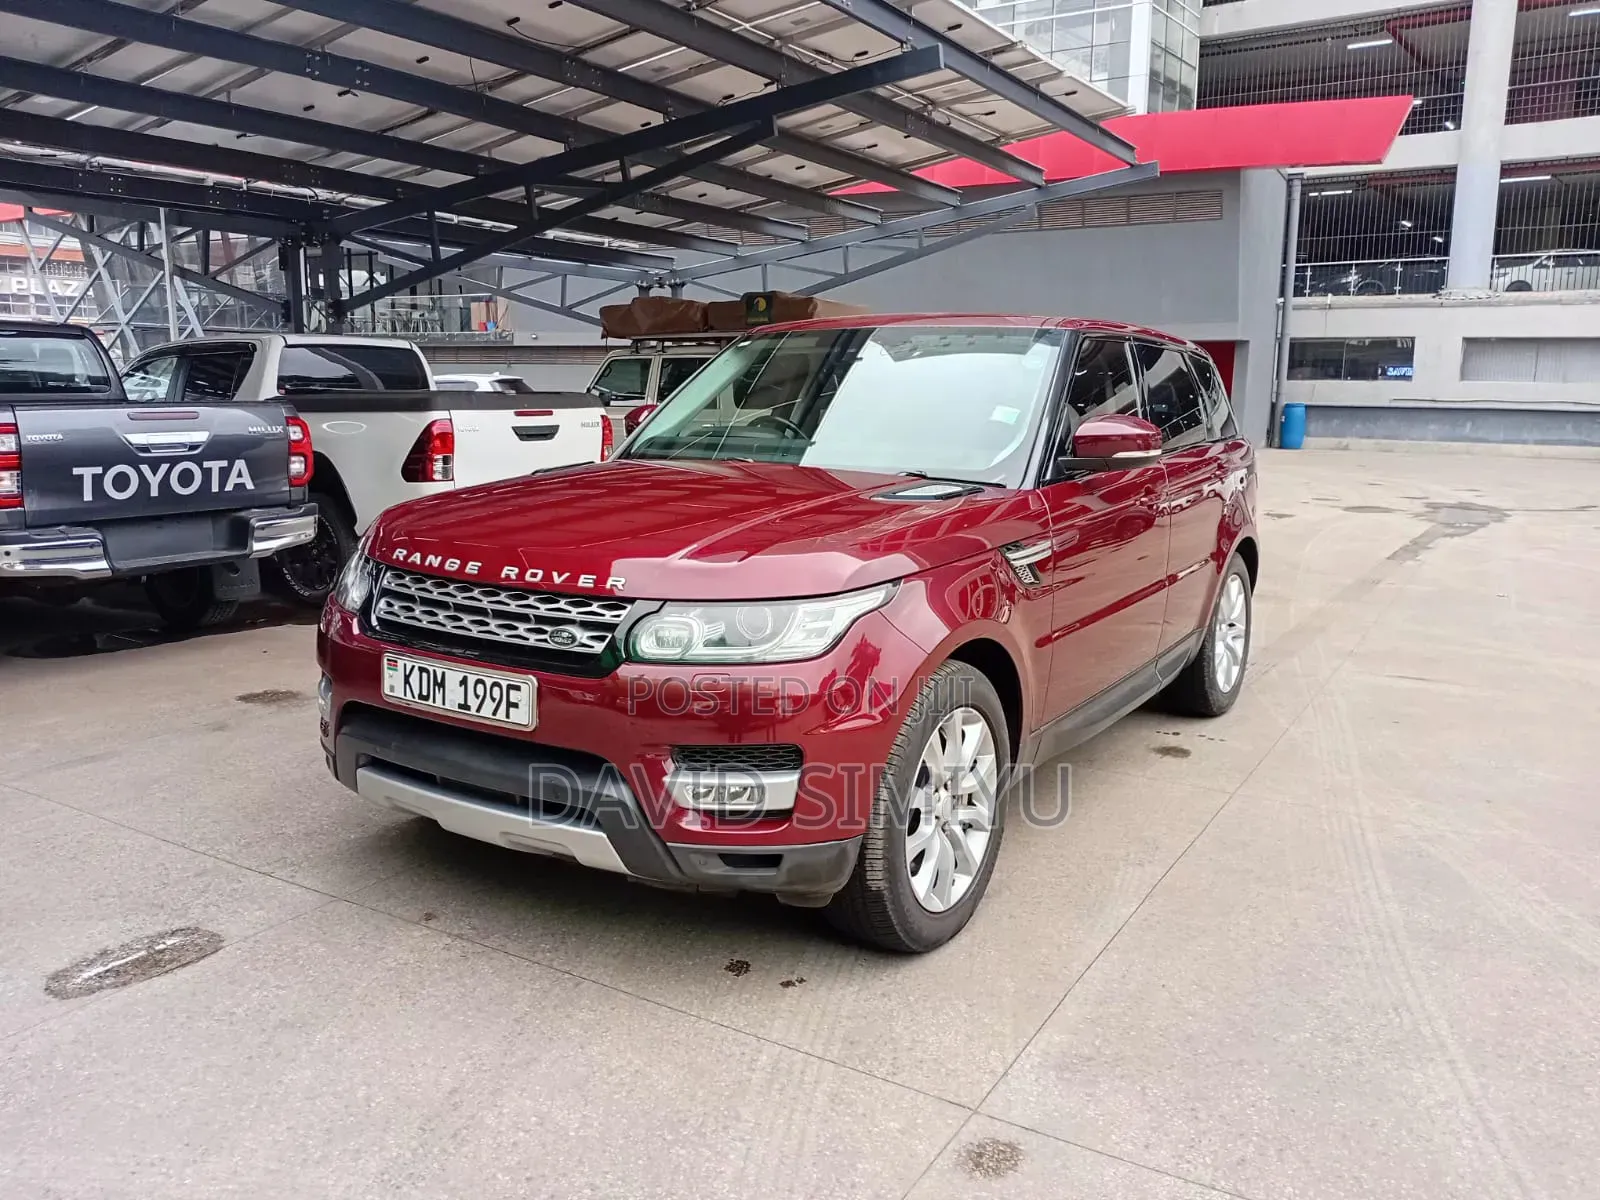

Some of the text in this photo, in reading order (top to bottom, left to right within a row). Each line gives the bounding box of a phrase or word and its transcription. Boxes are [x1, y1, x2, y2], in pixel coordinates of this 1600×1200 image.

[26, 433, 64, 442] TOYOTA
[248, 426, 284, 434] HILUX
[72, 459, 255, 501] TOYOTA
[392, 547, 626, 591] RANGE ROVER
[403, 663, 521, 719] KDM 199F
